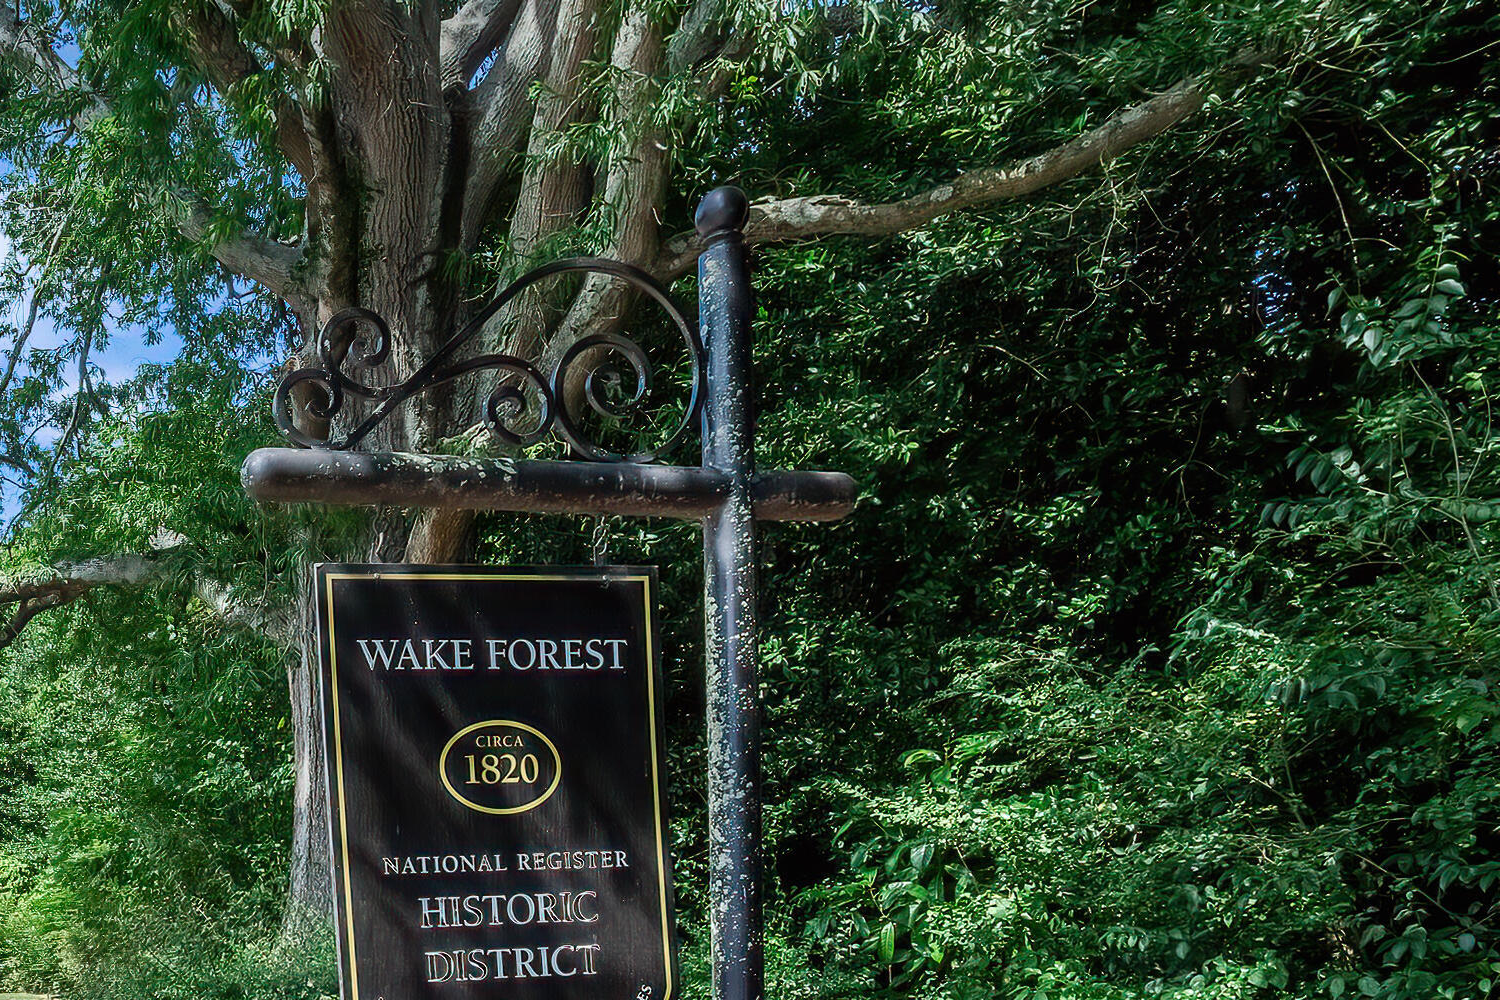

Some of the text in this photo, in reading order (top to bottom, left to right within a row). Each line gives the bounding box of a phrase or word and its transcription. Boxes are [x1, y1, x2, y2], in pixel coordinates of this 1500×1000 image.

[356, 638, 628, 671] WAKE FOREST
[475, 735, 524, 748] CIRCA
[464, 753, 539, 785] 1820
[382, 850, 629, 875] NATIONAL REGISTER
[418, 891, 599, 929] HISTORIC
[424, 944, 601, 983] DISTRICT
